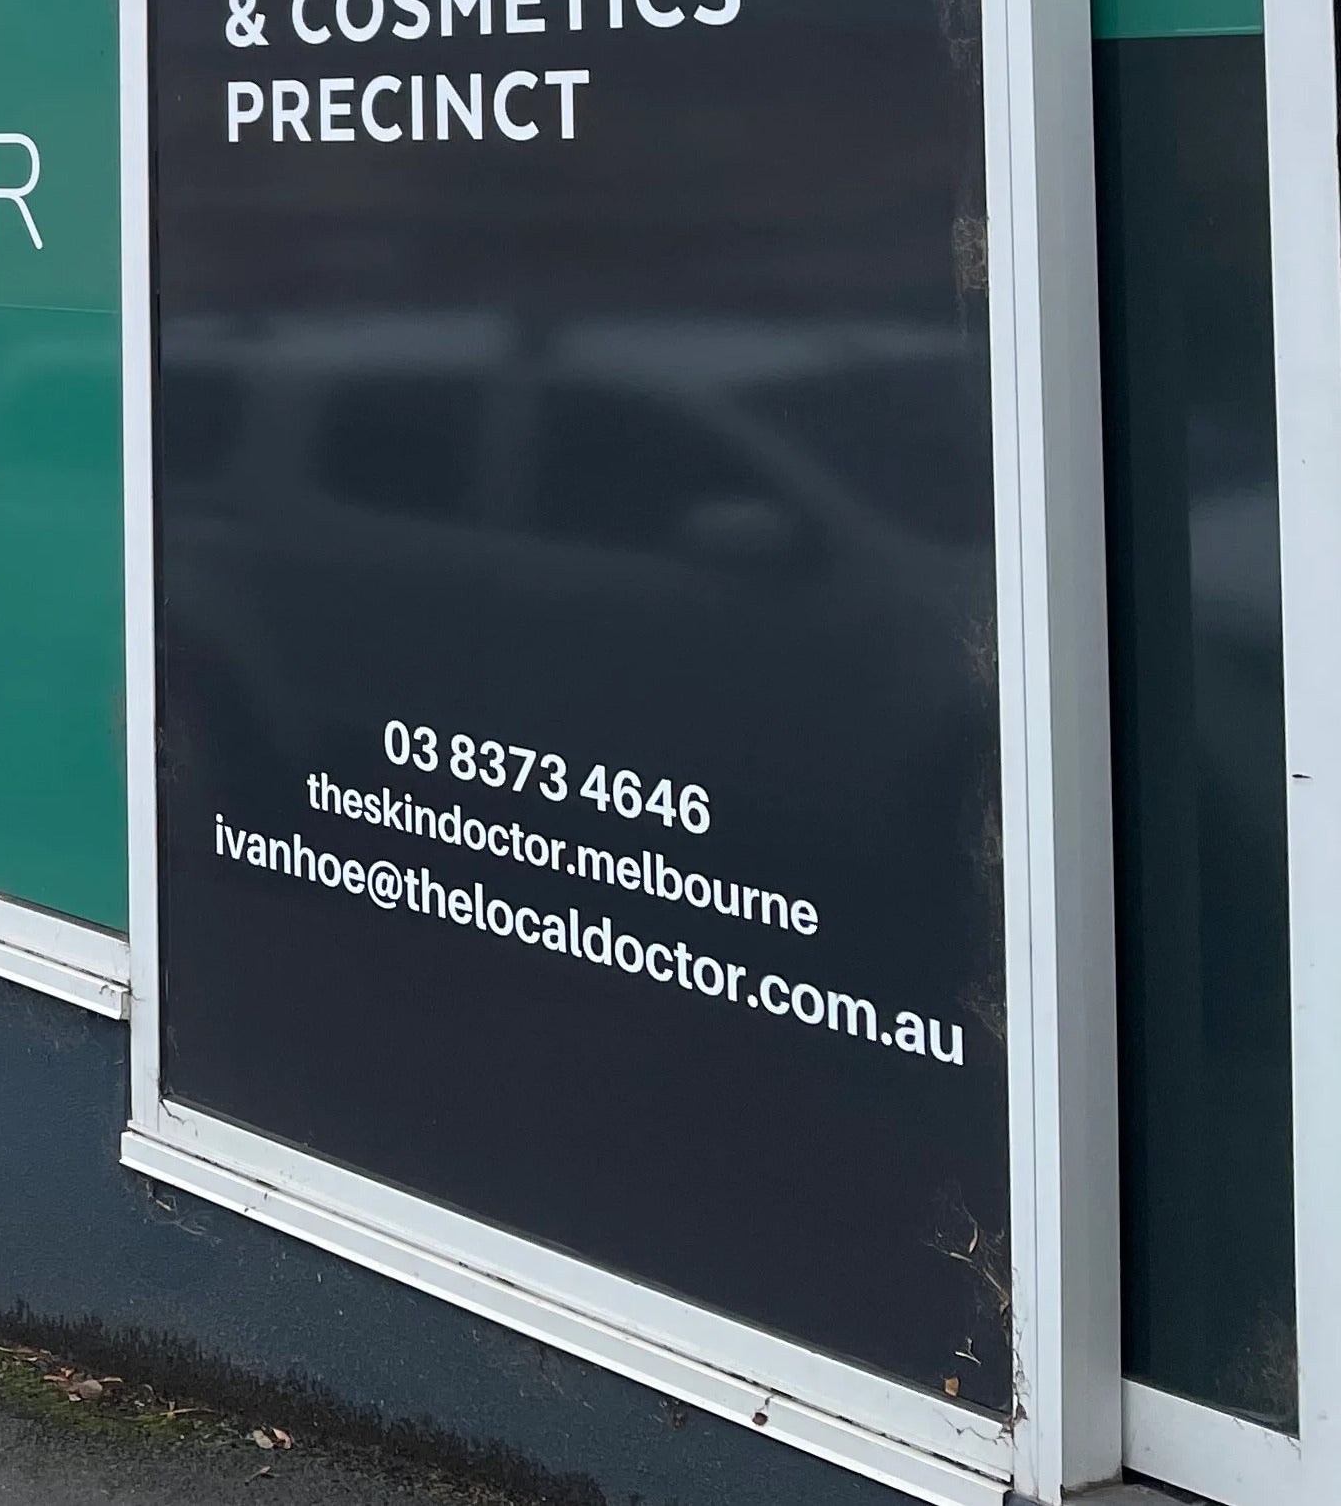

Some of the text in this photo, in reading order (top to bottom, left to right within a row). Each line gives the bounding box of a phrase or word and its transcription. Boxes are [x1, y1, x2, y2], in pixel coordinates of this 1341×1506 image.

[226, 69, 591, 143] PRECINCT
[383, 719, 710, 835] 03 8373 4646
[307, 772, 818, 935] theskindoctor.melbourne
[214, 813, 964, 1066] ivanhoe@thelocaldoctor.com.au
